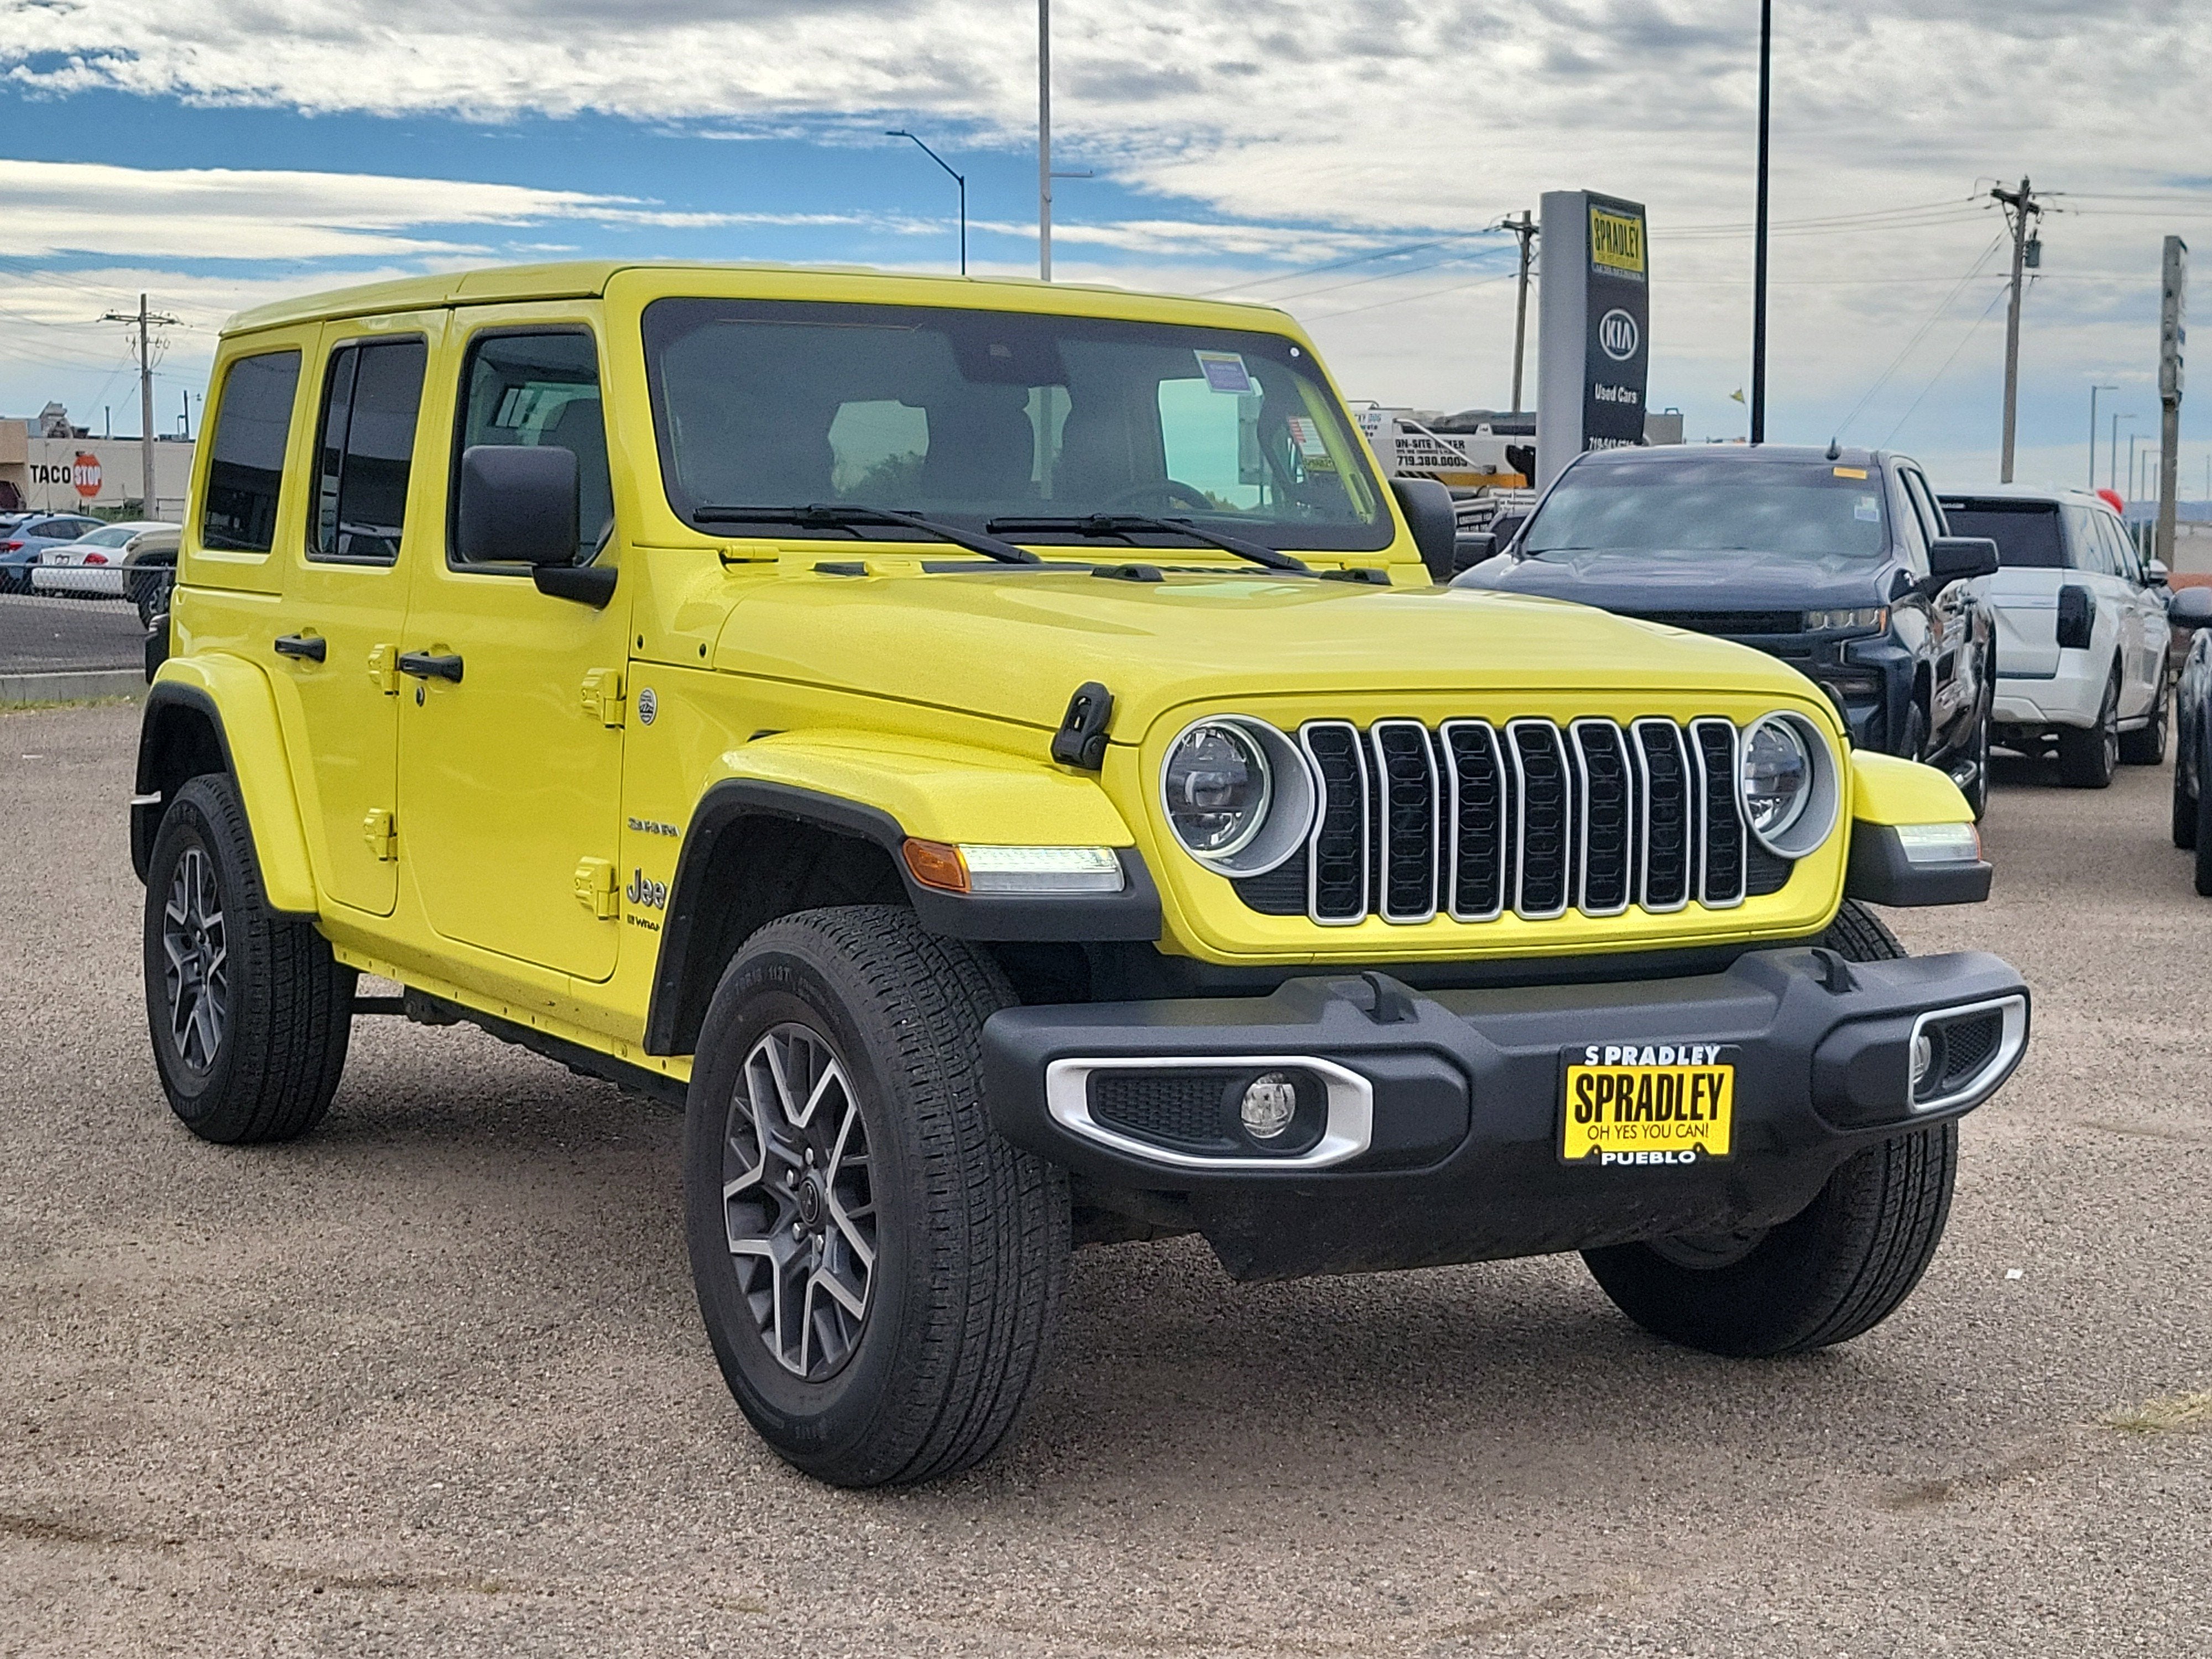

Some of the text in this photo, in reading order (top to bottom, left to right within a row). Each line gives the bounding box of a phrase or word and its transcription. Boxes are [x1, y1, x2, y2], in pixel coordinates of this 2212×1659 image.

[1594, 217, 1639, 259] SPRADLEY
[1606, 319, 1631, 349] KIA
[1595, 383, 1636, 404] Used Cars
[1395, 439, 1465, 448] ON-SITE MXER
[30, 465, 101, 486] TACO STOP
[627, 867, 666, 910] Jee
[1584, 1045, 1720, 1066] SPRADLEY
[1574, 1073, 1725, 1124] SPRADLEY
[1588, 1123, 1709, 1140] OH YES YOU CAN!
[1601, 1150, 1696, 1166] PUEBLO
